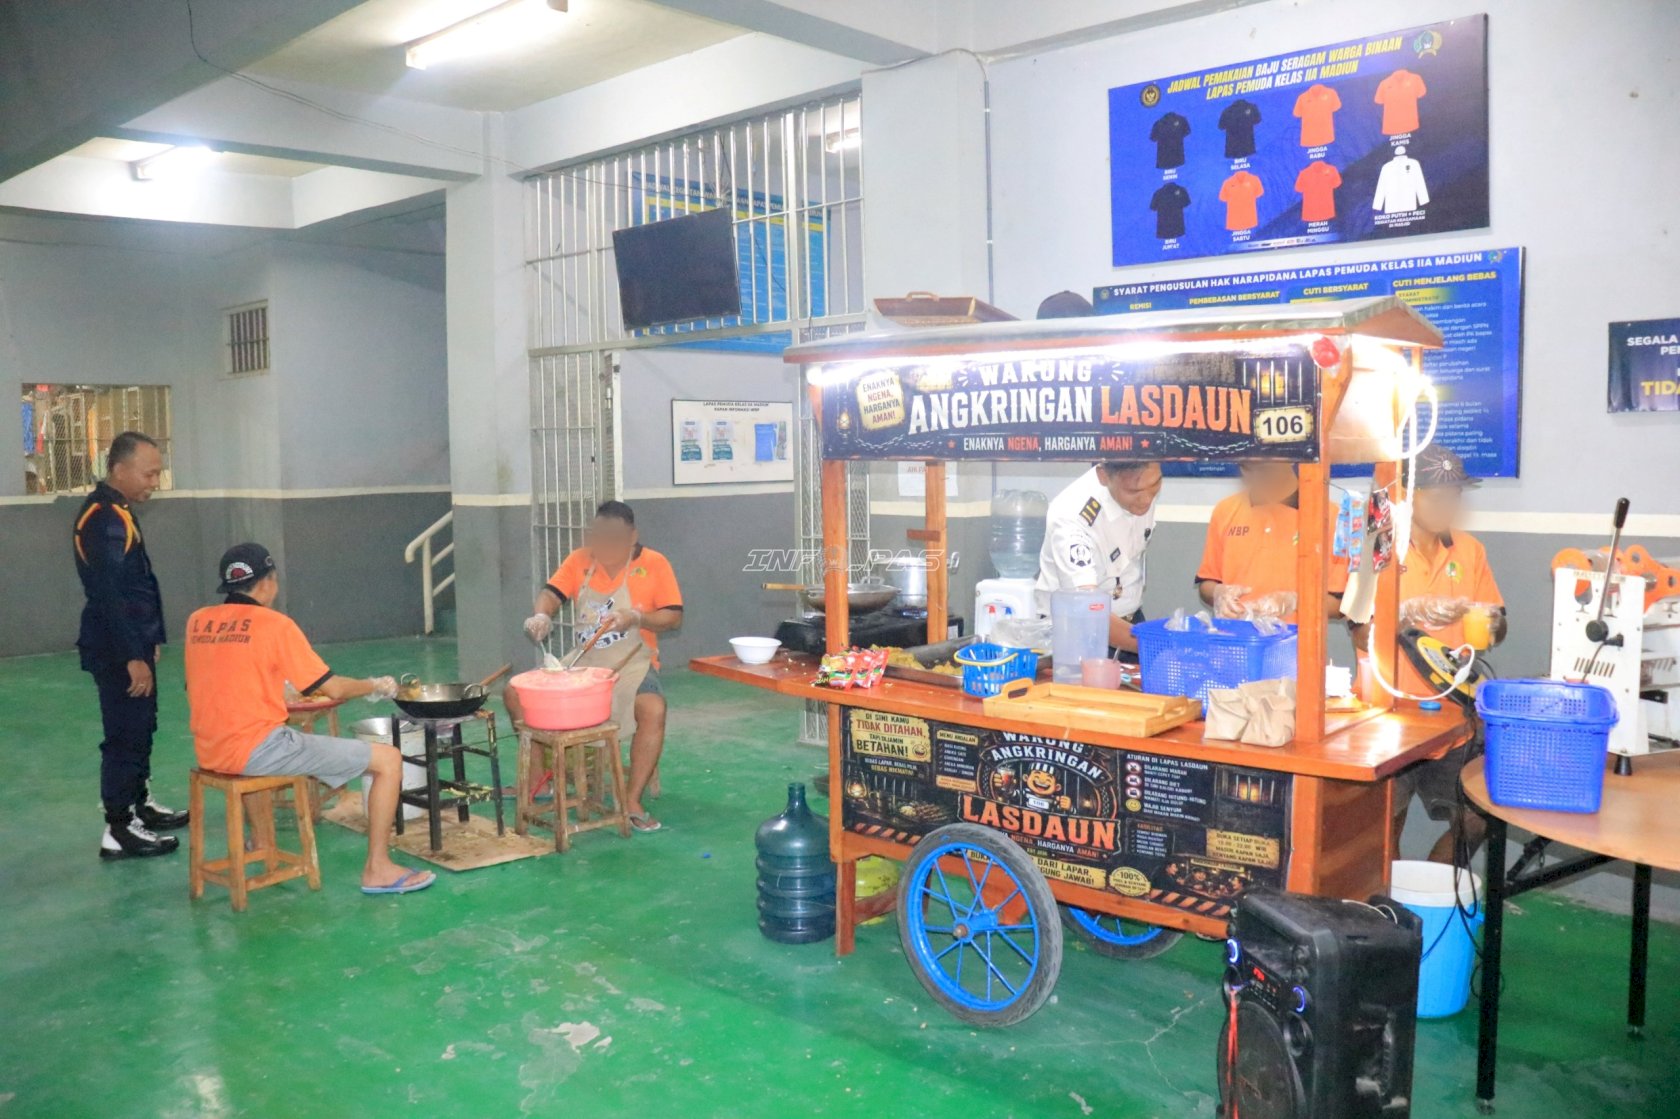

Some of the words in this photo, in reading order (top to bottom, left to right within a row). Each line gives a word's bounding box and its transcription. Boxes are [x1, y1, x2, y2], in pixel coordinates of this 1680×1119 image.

[1167, 76, 1201, 94] JADWAL
[1203, 65, 1254, 87] PEMAKAIAN
[1255, 60, 1280, 77] BAJU
[1281, 51, 1326, 72] SERAGAM
[1328, 44, 1363, 63] WARGA
[1365, 36, 1403, 56] BINAAN
[1206, 83, 1234, 100] LAPAS
[1235, 75, 1273, 94] PEMUDA
[1274, 69, 1303, 87] KELAS
[1304, 67, 1318, 82] IIA
[1319, 59, 1360, 79] MADIUN
[1307, 146, 1328, 154] JINGGA
[1114, 286, 1148, 296] SYARAT
[1149, 281, 1209, 293] PENGUSULAN
[1211, 278, 1230, 287] HAK
[1232, 272, 1297, 285] NARAPIDANA
[1299, 268, 1332, 279] LAPAS
[1334, 264, 1378, 276] PEMUDA
[1380, 259, 1415, 271] KELAS
[1417, 258, 1432, 268] IIA
[1435, 253, 1483, 266] MADIUN
[1392, 279, 1412, 288] CUTI
[1413, 274, 1466, 286] MENJELANG
[1466, 271, 1497, 281] BEBAS
[1303, 287, 1322, 296] CUTI
[1323, 282, 1369, 293] BERSYARAT
[1189, 294, 1237, 305] PEMBEBASAN
[1238, 290, 1281, 301] BERSYARAT
[1129, 302, 1152, 310] REMISI
[1626, 334, 1679, 346] SEGALA
[1660, 345, 1680, 355] PE
[979, 359, 1093, 386] WARUNG
[862, 377, 895, 393] ENAKNYA
[867, 389, 894, 403] NGENA,
[863, 399, 900, 414] HARGANYA
[908, 386, 1093, 436] ANGKRINGAN
[1100, 384, 1252, 435] LASDAUN
[872, 410, 896, 424] AMAN!
[1262, 415, 1304, 436] 106
[963, 437, 1005, 451] ENAKNYA
[1007, 437, 1042, 452] NGENA,
[1044, 436, 1096, 451] HARGANYA
[1100, 436, 1133, 451] AMAN!
[193, 618, 252, 634] LAPAS
[875, 714, 888, 722] SINI
[891, 715, 910, 724] KAMU
[856, 719, 881, 732] TIDAK
[883, 723, 926, 739] DITAHAN,
[856, 739, 909, 757] BETAHAN!
[991, 745, 1103, 779] ANGKRINGAN
[1126, 753, 1150, 762] ATURAN
[1159, 758, 1179, 767] LAPAS
[1180, 761, 1209, 771] LASDAUN
[1144, 764, 1169, 773] DILARANG
[1144, 777, 1169, 786] DILARANG
[1144, 789, 1167, 799] DILARANG
[1159, 804, 1182, 813] SENYUM
[963, 795, 1115, 850] LASDAUN
[1037, 840, 1075, 853] HARGANYA
[1076, 847, 1099, 858] AMAN!
[1037, 859, 1058, 869] DARI
[1061, 864, 1092, 878] LAPAR,
[1120, 871, 1140, 881] 100%
[1063, 871, 1095, 886] JAWAB!
